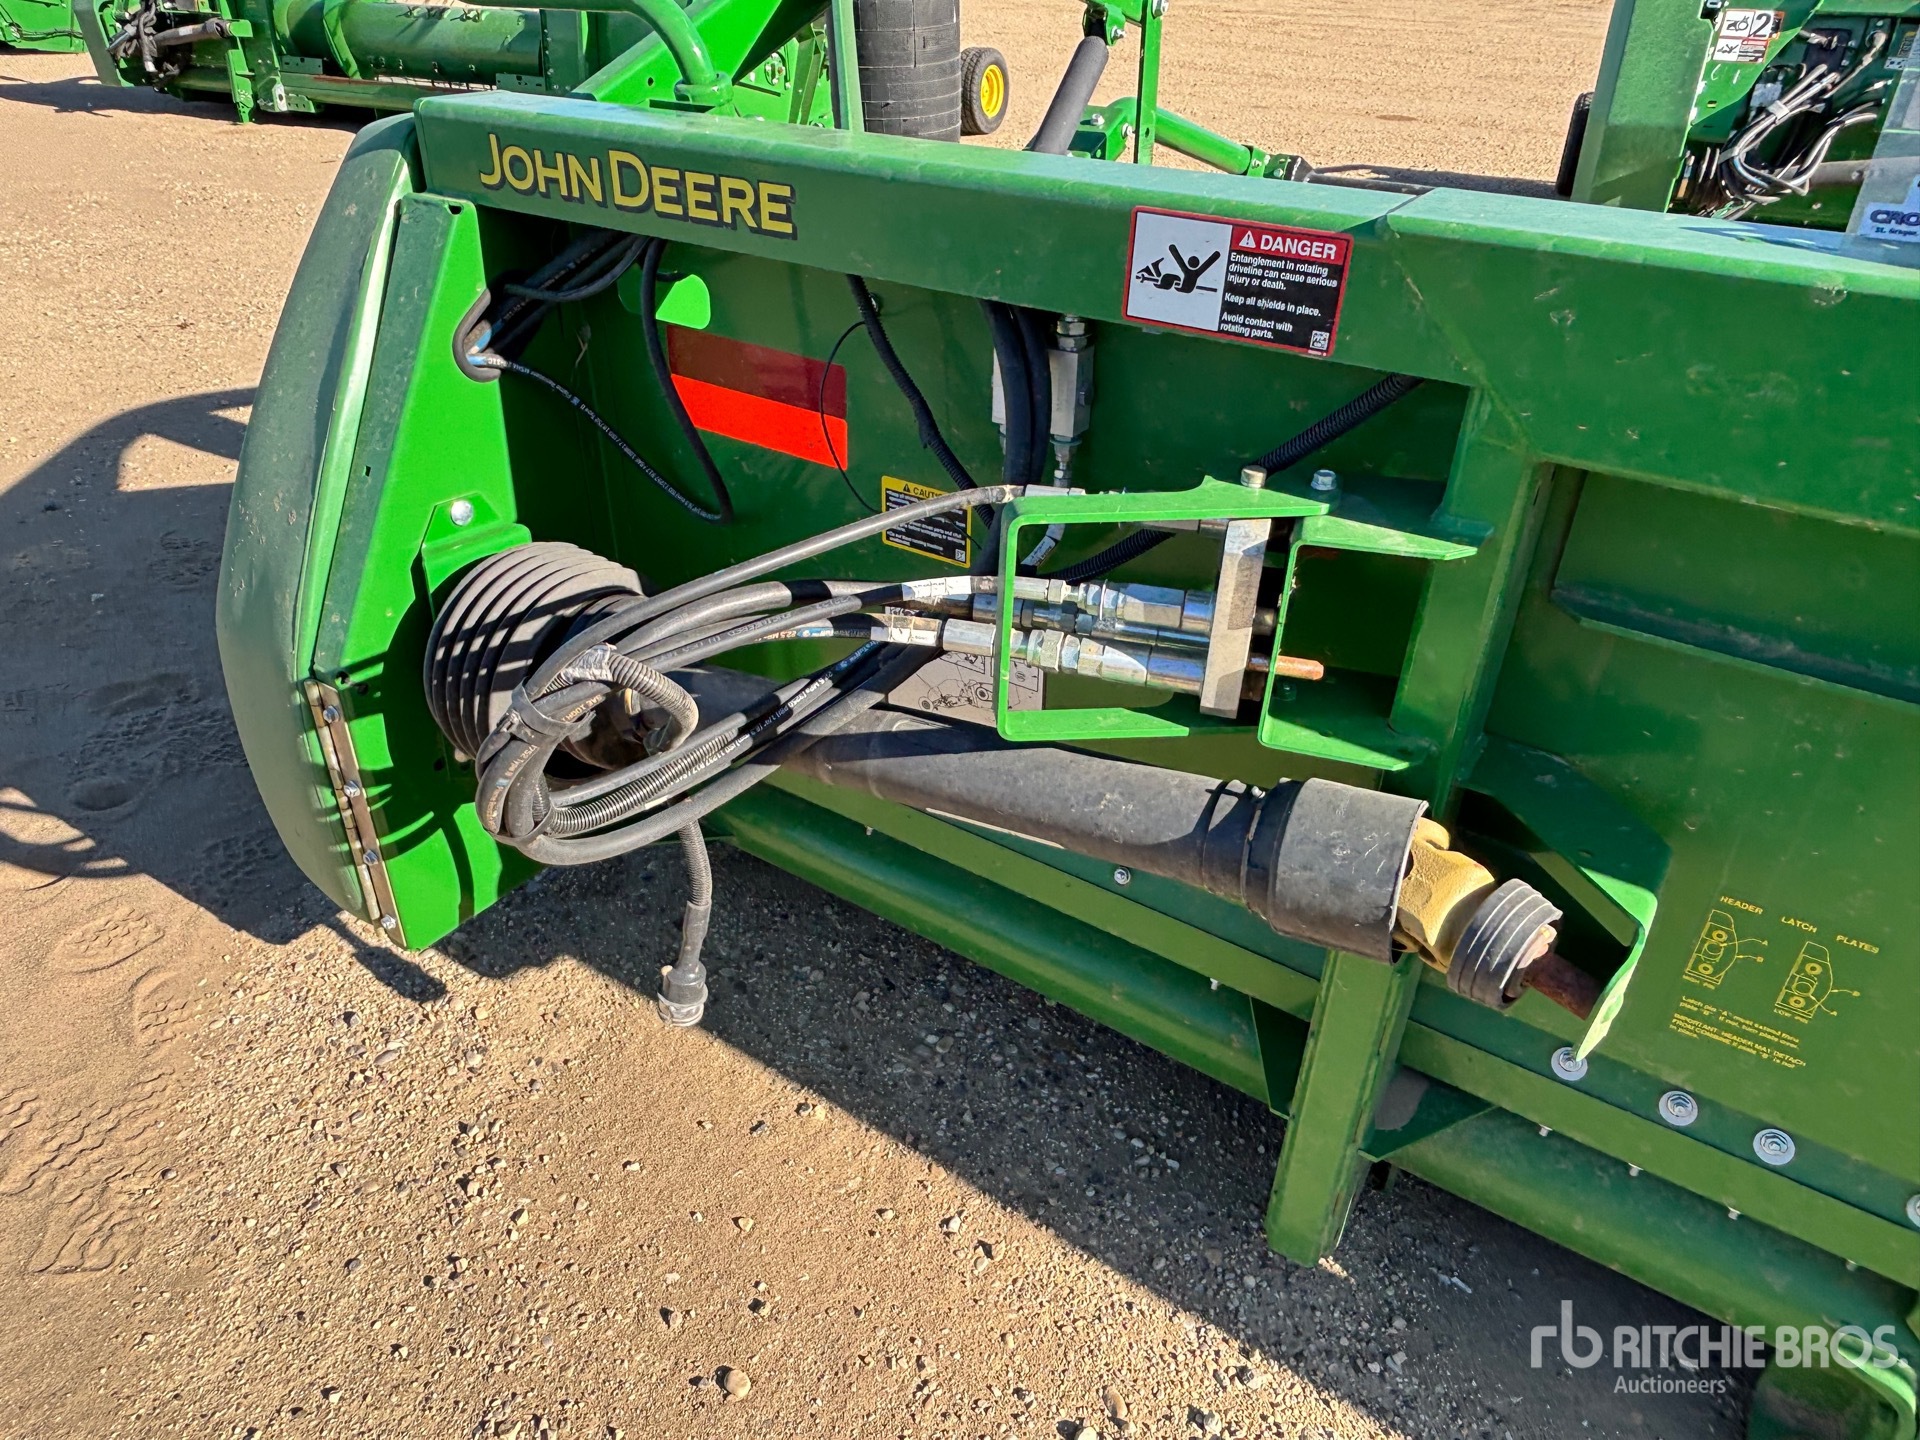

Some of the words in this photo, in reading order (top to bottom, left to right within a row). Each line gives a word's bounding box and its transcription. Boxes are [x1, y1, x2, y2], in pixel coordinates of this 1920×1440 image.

[1751, 13, 1772, 38] 2
[479, 133, 607, 207] JOHN
[608, 150, 797, 240] DEERE
[1261, 234, 1337, 260] DANGER
[1228, 264, 1263, 277] driveline
[1264, 269, 1279, 279] can
[1280, 271, 1305, 283] cause
[1306, 273, 1338, 287] serious
[1230, 253, 1285, 269] Entanglement
[1287, 260, 1294, 270] in
[1296, 261, 1328, 276] rotating
[1227, 274, 1251, 288] injury
[1252, 279, 1260, 287] or
[1261, 278, 1287, 290] death.
[1224, 292, 1245, 306] Keep
[1246, 296, 1256, 306] all
[1257, 298, 1286, 312] shields
[1287, 302, 1296, 312] in
[1297, 303, 1322, 317] place.
[1220, 322, 1250, 337] rotating
[1251, 328, 1274, 340] parts.
[1221, 311, 1245, 325] Avoid
[1245, 316, 1275, 330] contact
[1276, 321, 1293, 333] with
[1720, 895, 1763, 915] HEADER
[1781, 916, 1817, 933] LATCH
[1836, 934, 1880, 954] PLATES
